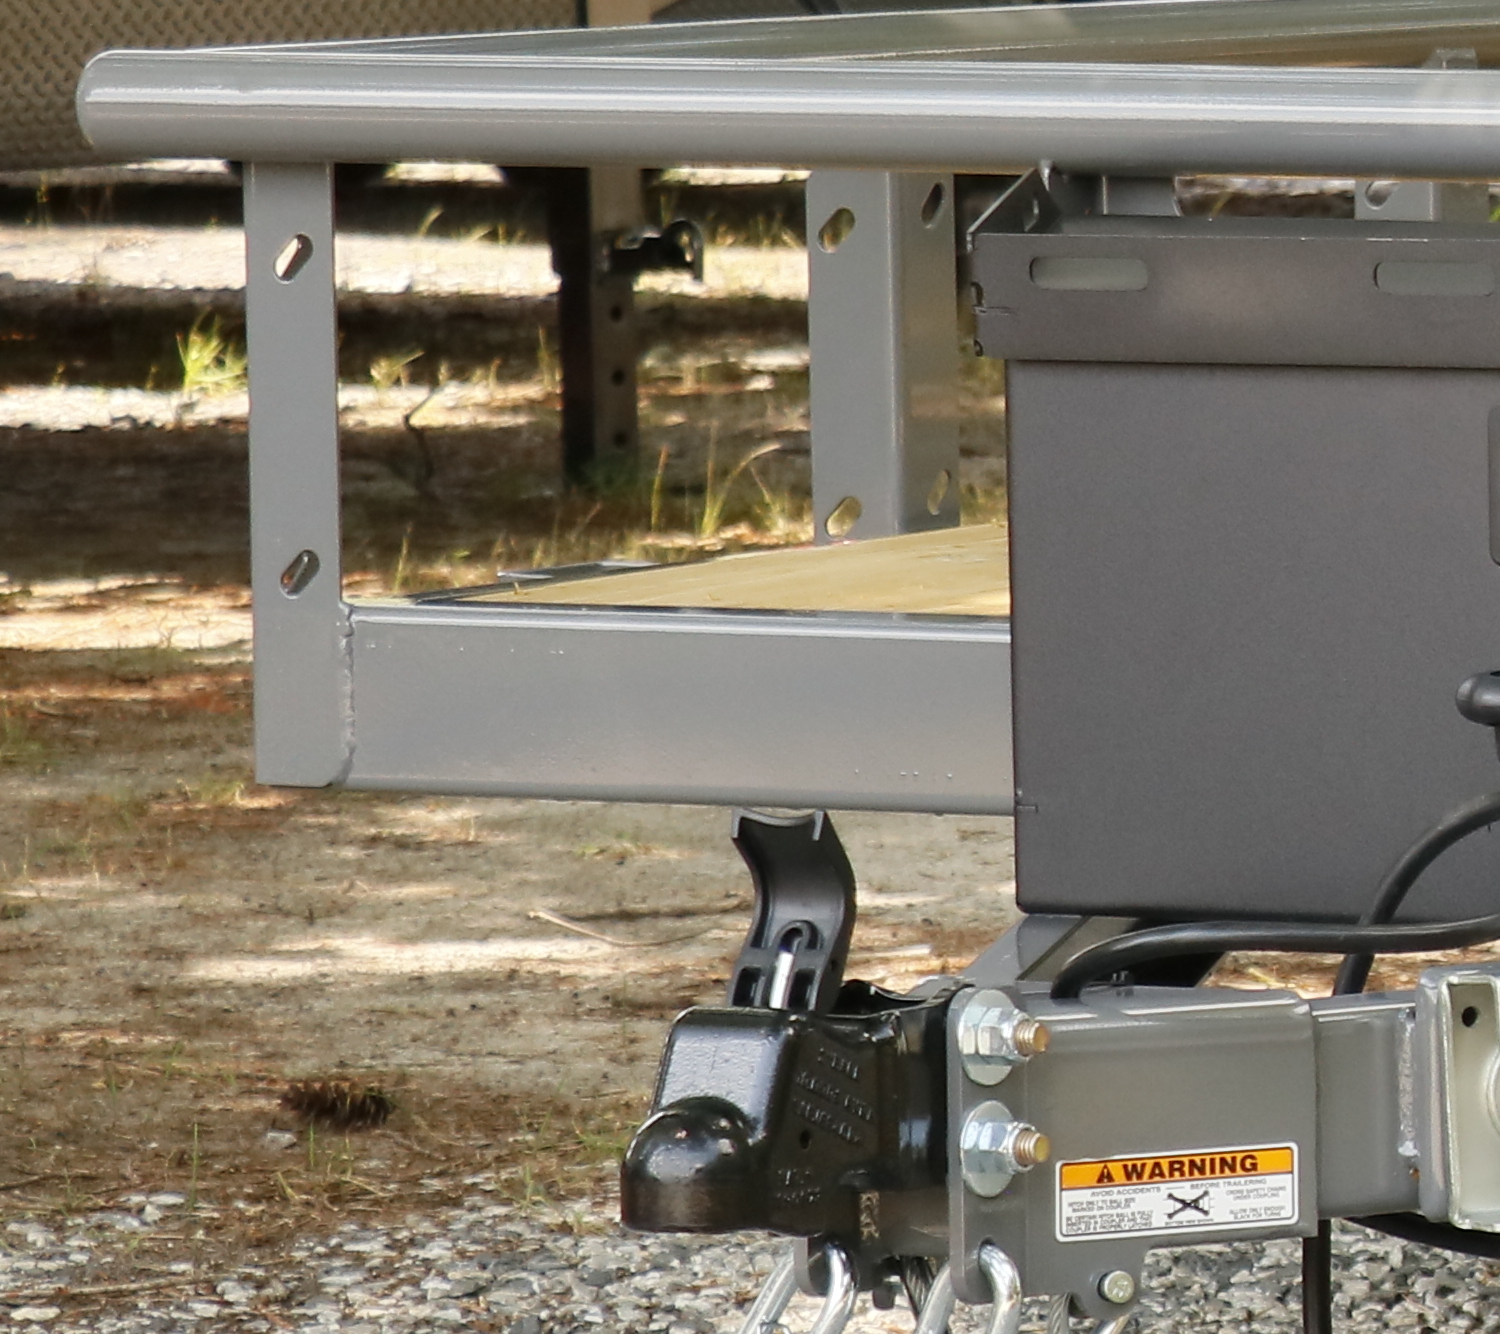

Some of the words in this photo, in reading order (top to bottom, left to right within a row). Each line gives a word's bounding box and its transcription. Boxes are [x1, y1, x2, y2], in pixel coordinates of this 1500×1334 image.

[1122, 1154, 1259, 1182] WARNING
[1090, 1189, 1115, 1198] AVOID
[1116, 1186, 1161, 1196] ACCIDENTS
[1190, 1181, 1221, 1190] BEFORE
[1223, 1178, 1267, 1188] TRAILERING
